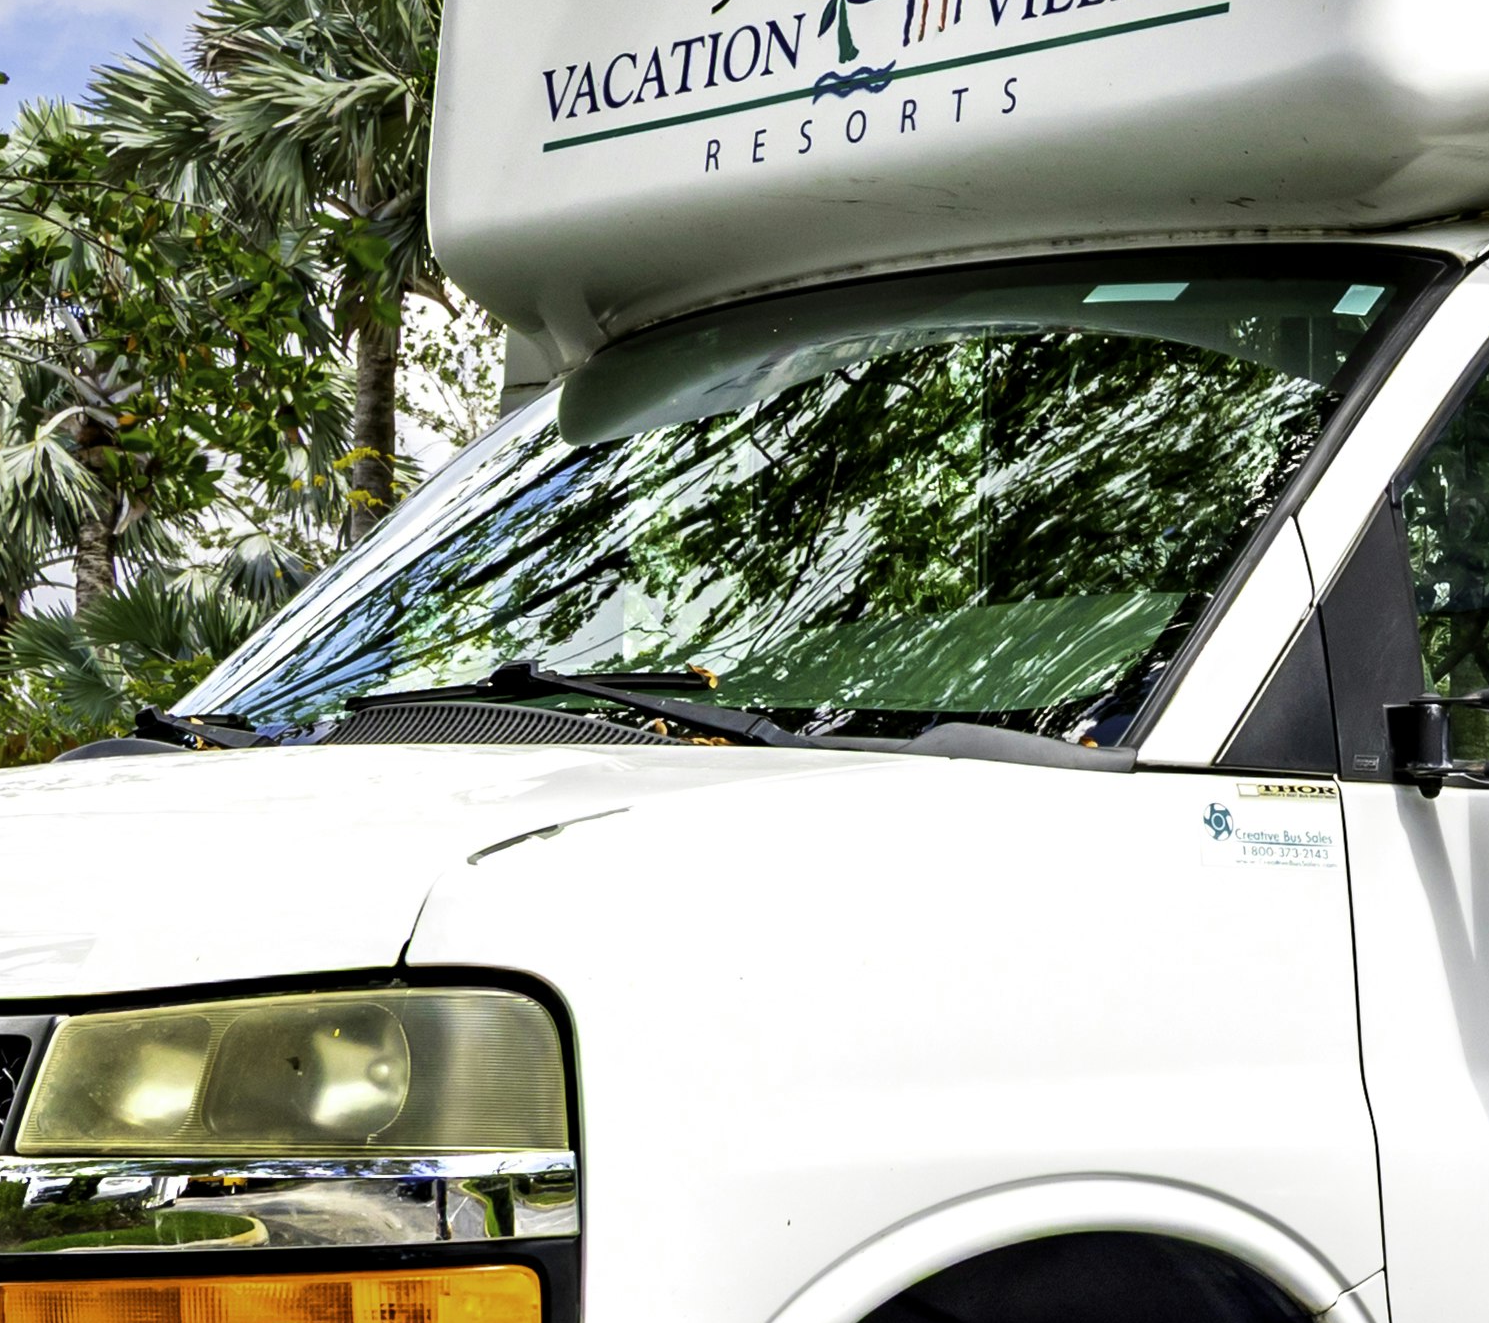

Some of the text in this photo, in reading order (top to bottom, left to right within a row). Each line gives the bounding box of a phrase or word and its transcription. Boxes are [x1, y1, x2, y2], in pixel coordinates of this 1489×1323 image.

[541, 11, 807, 121] VACATION
[705, 76, 1020, 172] RESORTS
[1258, 784, 1337, 795] THOR
[1234, 828, 1333, 844] Creative Bus Sales
